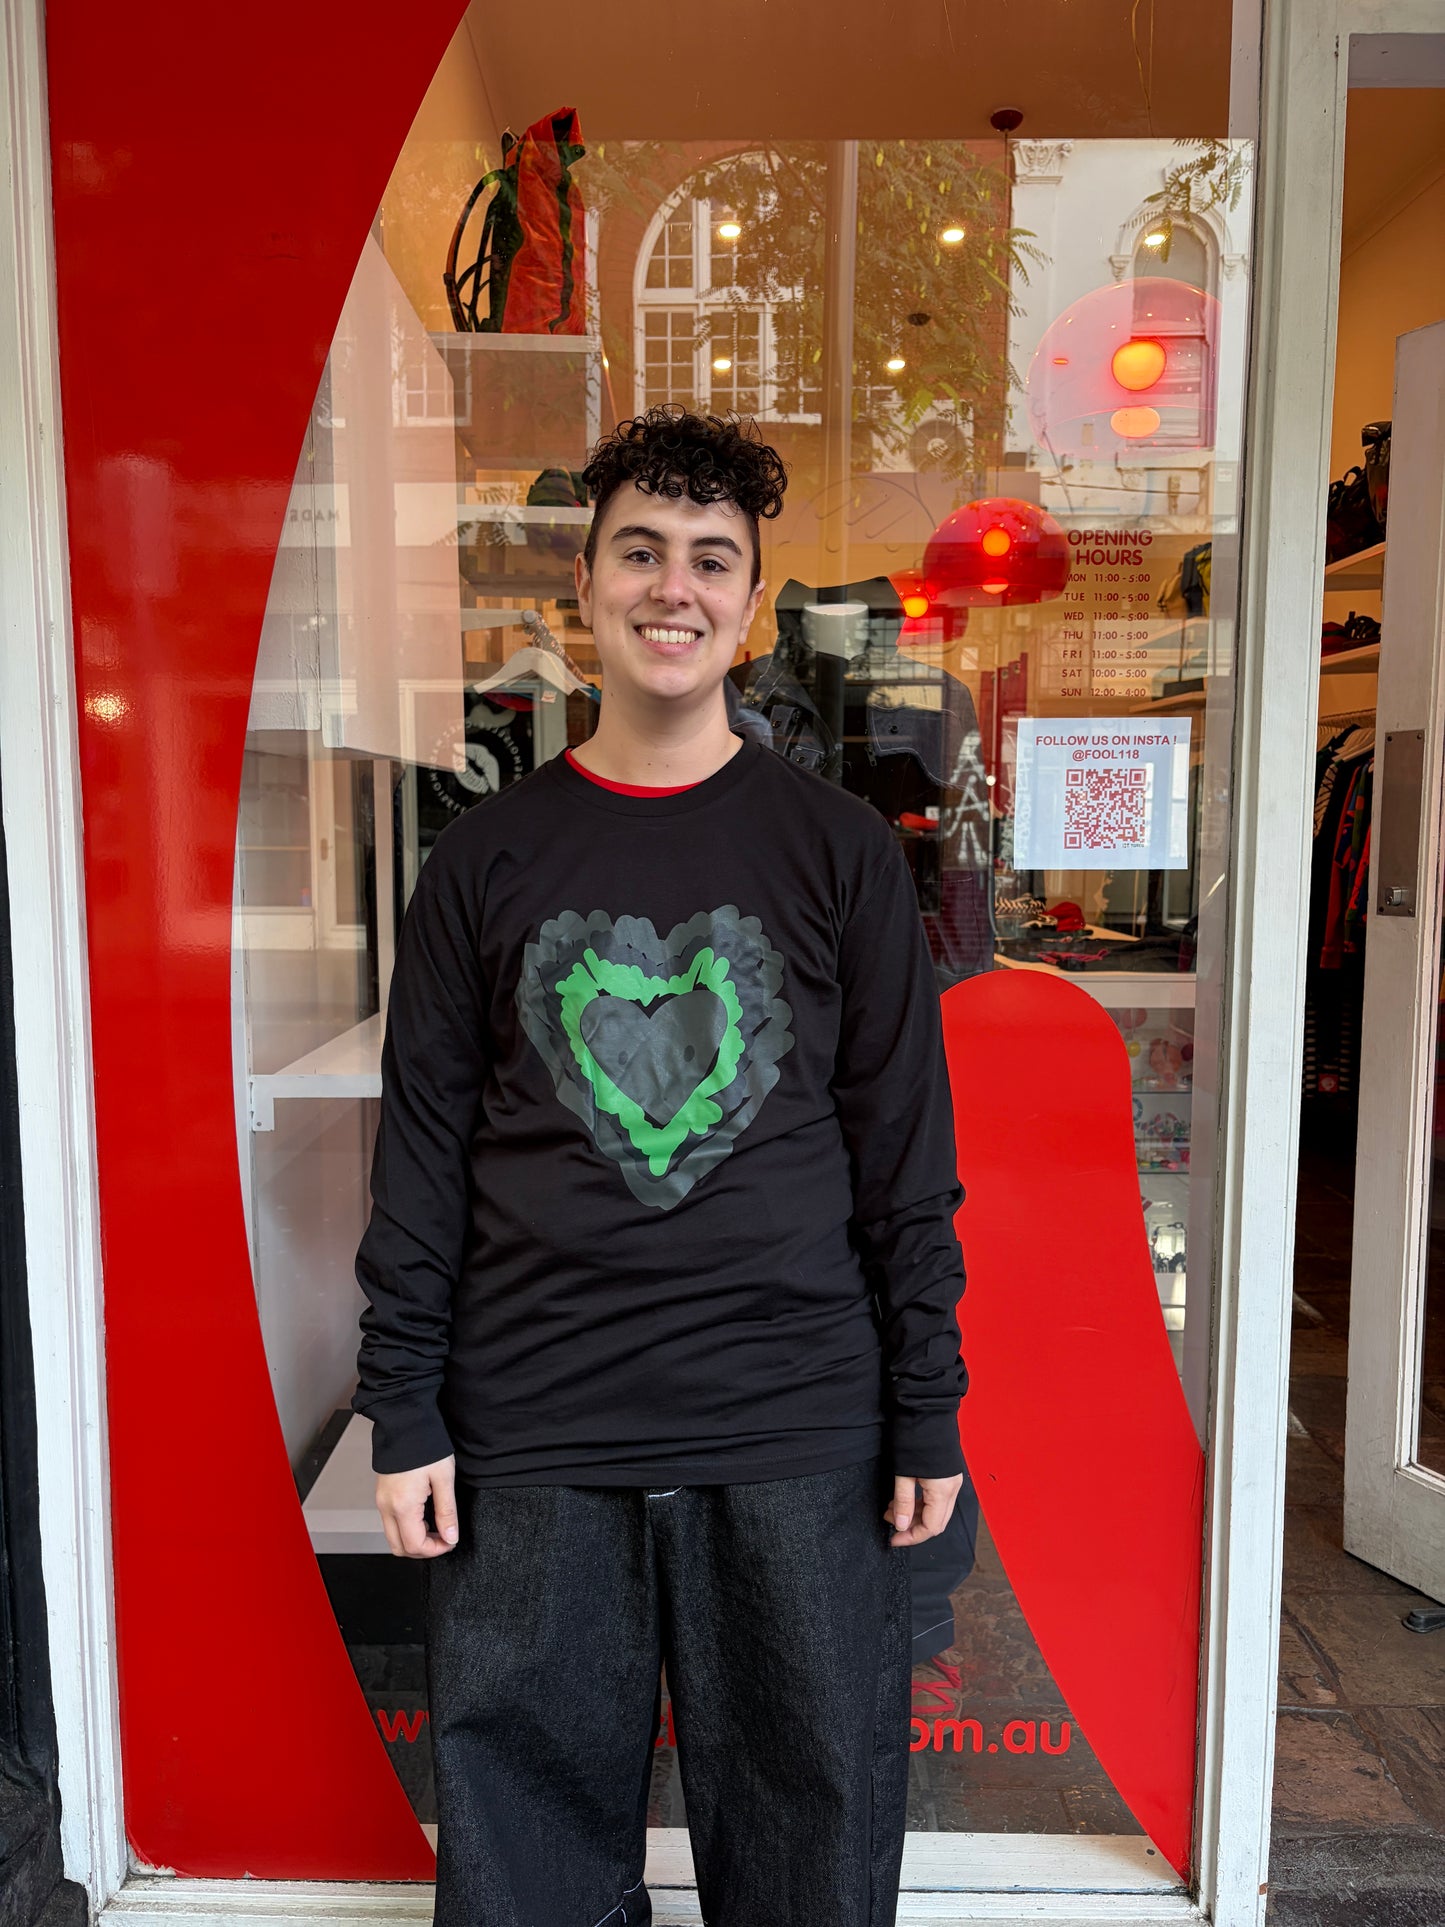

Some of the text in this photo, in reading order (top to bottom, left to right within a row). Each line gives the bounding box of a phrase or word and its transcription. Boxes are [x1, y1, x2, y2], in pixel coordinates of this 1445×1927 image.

[1068, 530, 1152, 546] OPENING
[1076, 549, 1143, 566] HOURS
[1066, 574, 1086, 582] MON
[1095, 574, 1119, 582] 11:00
[1129, 574, 1150, 582] 5:00
[1065, 593, 1085, 601] TUE
[1094, 593, 1119, 601] 11:00
[1128, 593, 1149, 601] 5:00
[1064, 612, 1084, 621] WED
[1093, 612, 1118, 621] 11:00
[1128, 612, 1149, 621] 5:00
[1064, 631, 1083, 640] THU
[1093, 631, 1117, 640] 11:00
[1127, 631, 1148, 640] 5:00
[1063, 650, 1082, 659] FRI
[1092, 650, 1116, 659] 11:00
[1126, 650, 1147, 659] 5:00
[1062, 669, 1082, 678] SAT
[1091, 669, 1116, 678] 10:00
[1125, 669, 1146, 678] 5:00
[1061, 688, 1081, 697] SUN
[1090, 688, 1115, 697] 12:00
[1125, 688, 1146, 697] 4:00
[1036, 736, 1089, 745] FOLLOW
[1092, 736, 1108, 745] US
[1112, 736, 1130, 745] ON
[1134, 736, 1169, 745] INSTA
[1072, 750, 1139, 761] @FOOL118
